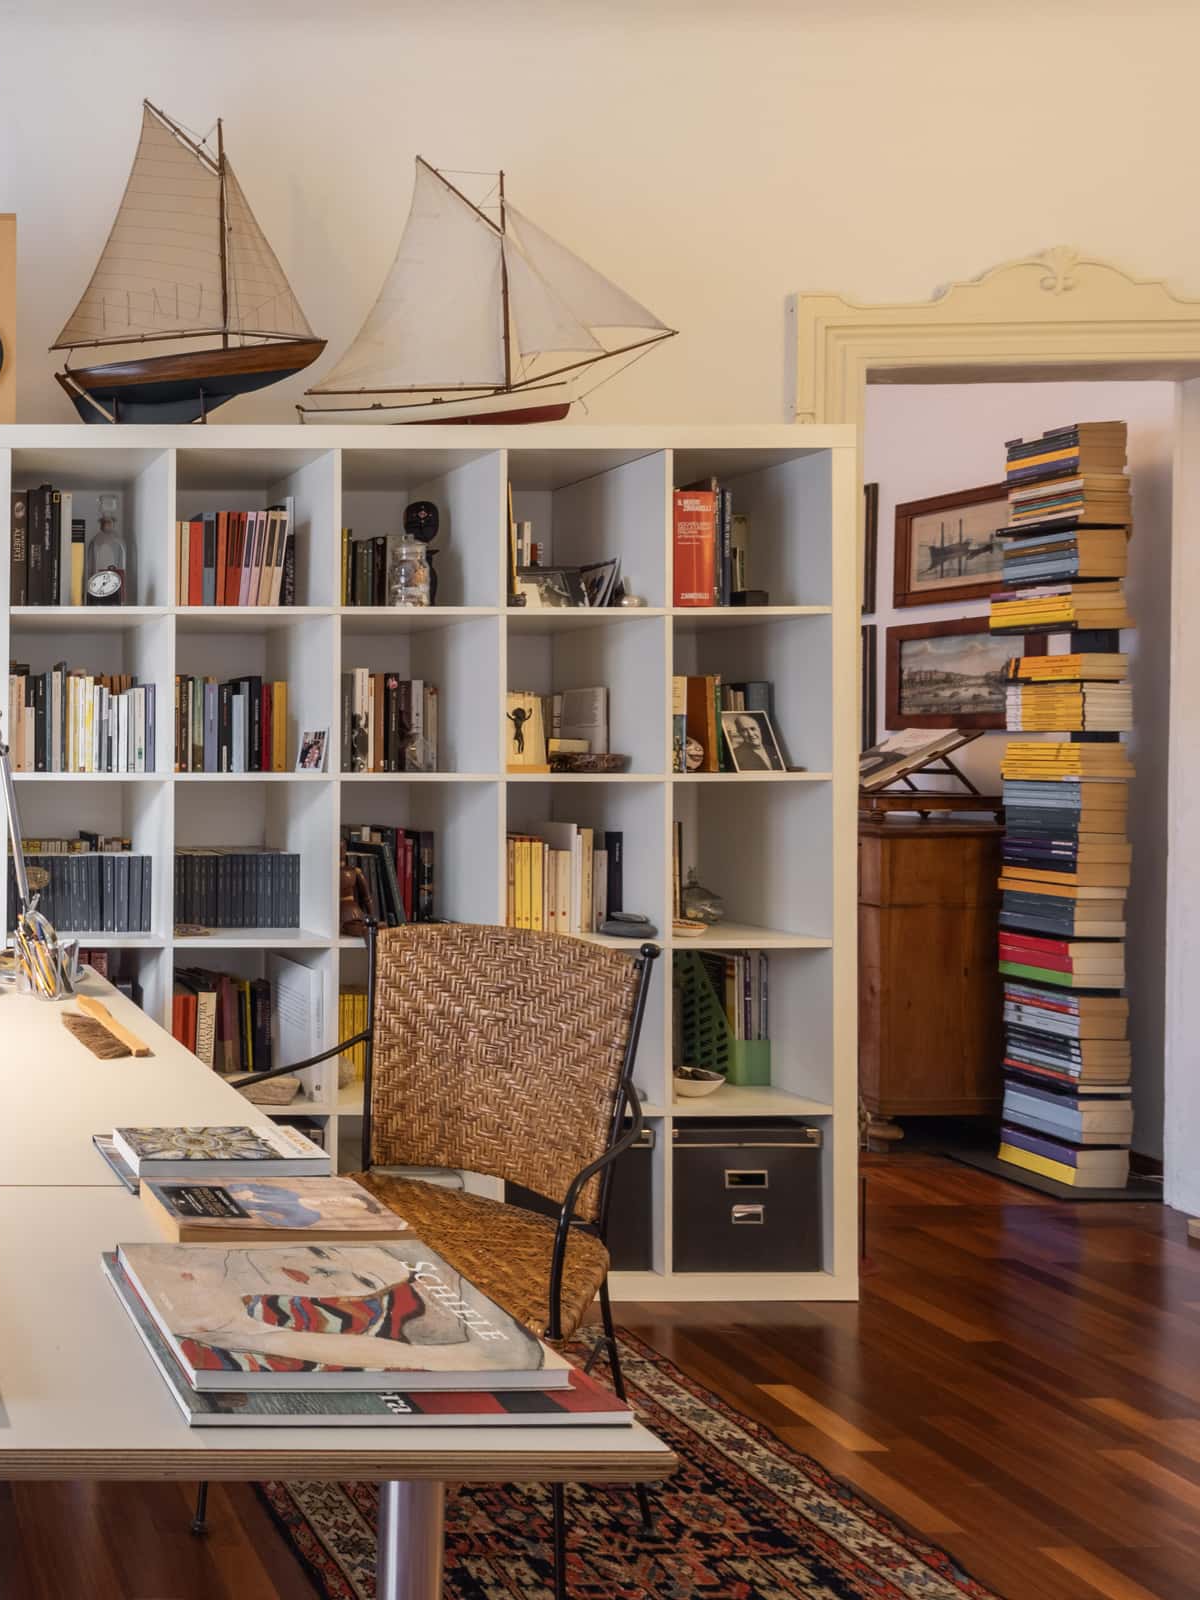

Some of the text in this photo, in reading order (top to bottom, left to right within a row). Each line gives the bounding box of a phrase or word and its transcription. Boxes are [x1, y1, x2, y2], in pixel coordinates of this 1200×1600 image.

[13, 527, 21, 562] ALBERTI
[399, 1261, 511, 1341] SCHIELE
[376, 1392, 413, 1414] ra
